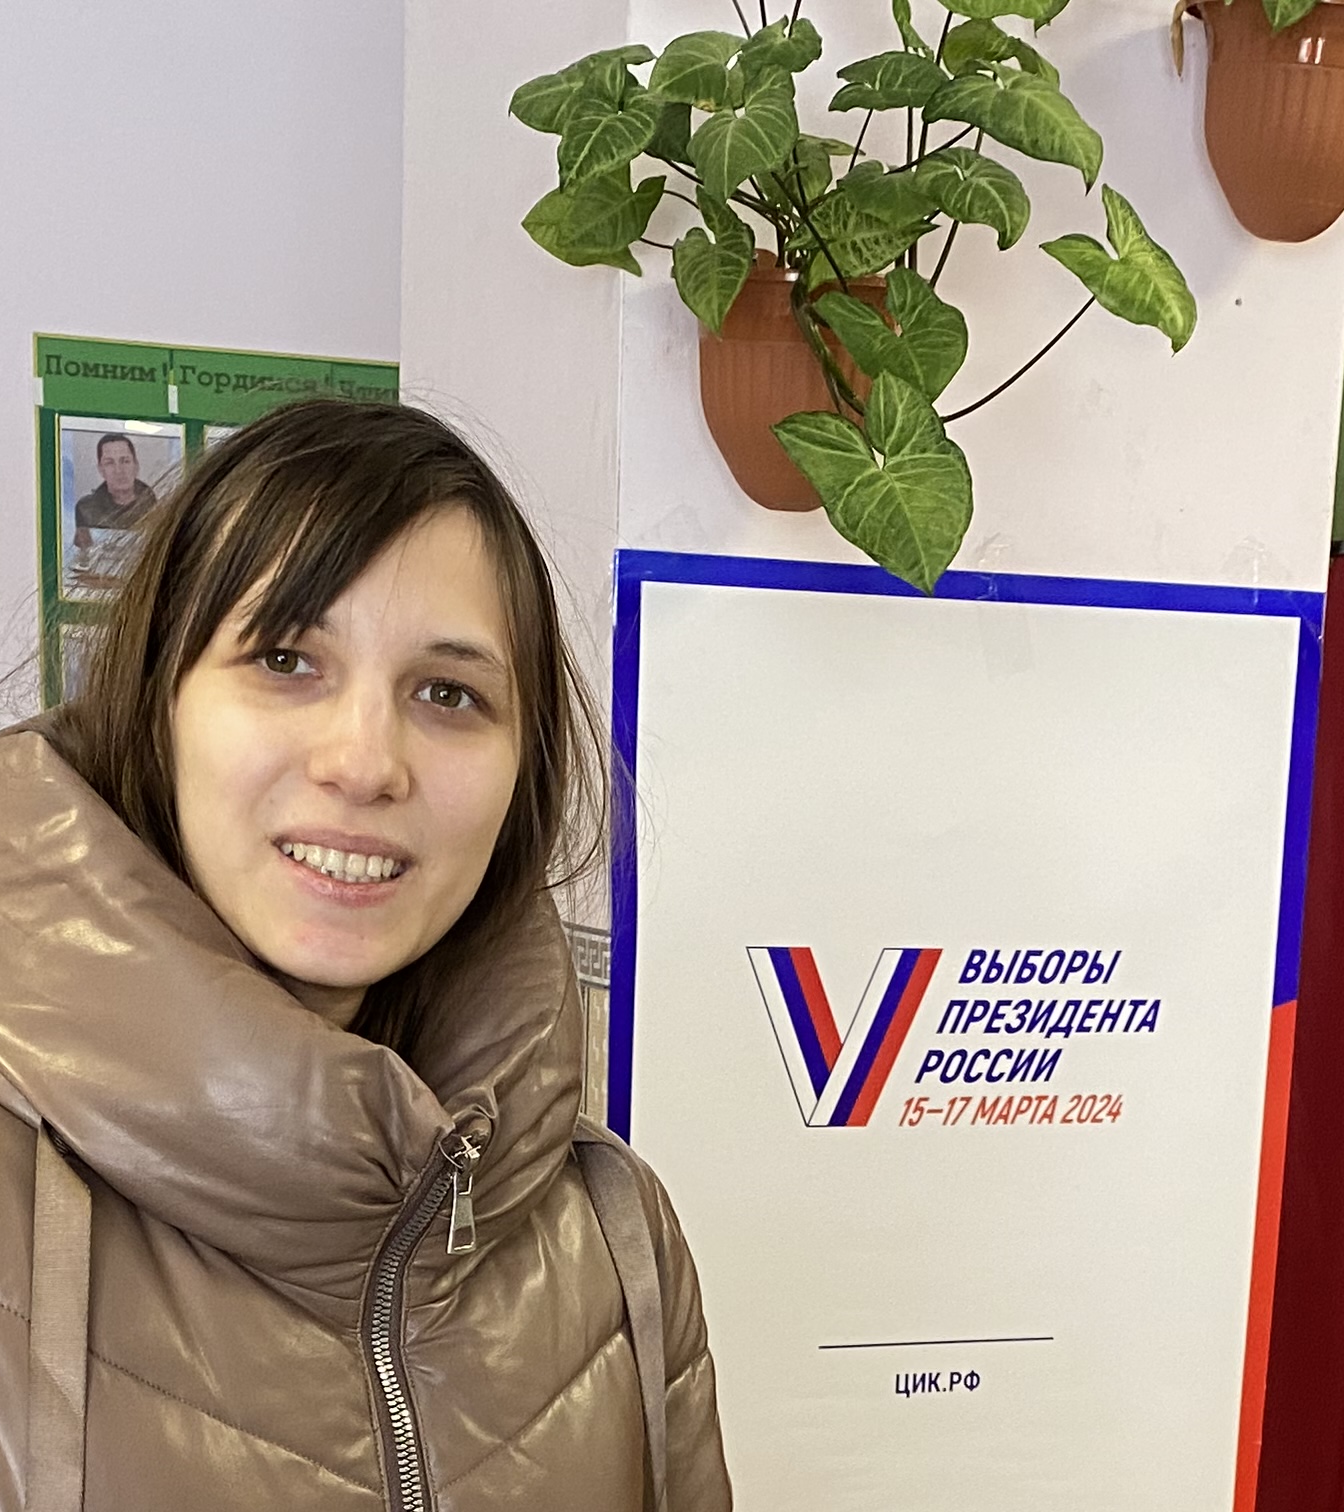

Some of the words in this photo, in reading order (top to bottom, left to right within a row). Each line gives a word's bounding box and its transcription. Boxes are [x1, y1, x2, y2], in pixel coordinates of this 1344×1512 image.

[958, 948, 1122, 985] ВЫБОРЫ
[936, 998, 1162, 1039] ПРЕЗИДЕНТА
[914, 1048, 1062, 1084] РОССИИ
[970, 1094, 1058, 1126] МАРТА
[1060, 1093, 1124, 1125] 2024
[894, 1369, 982, 1399] ЦИК.РФ
